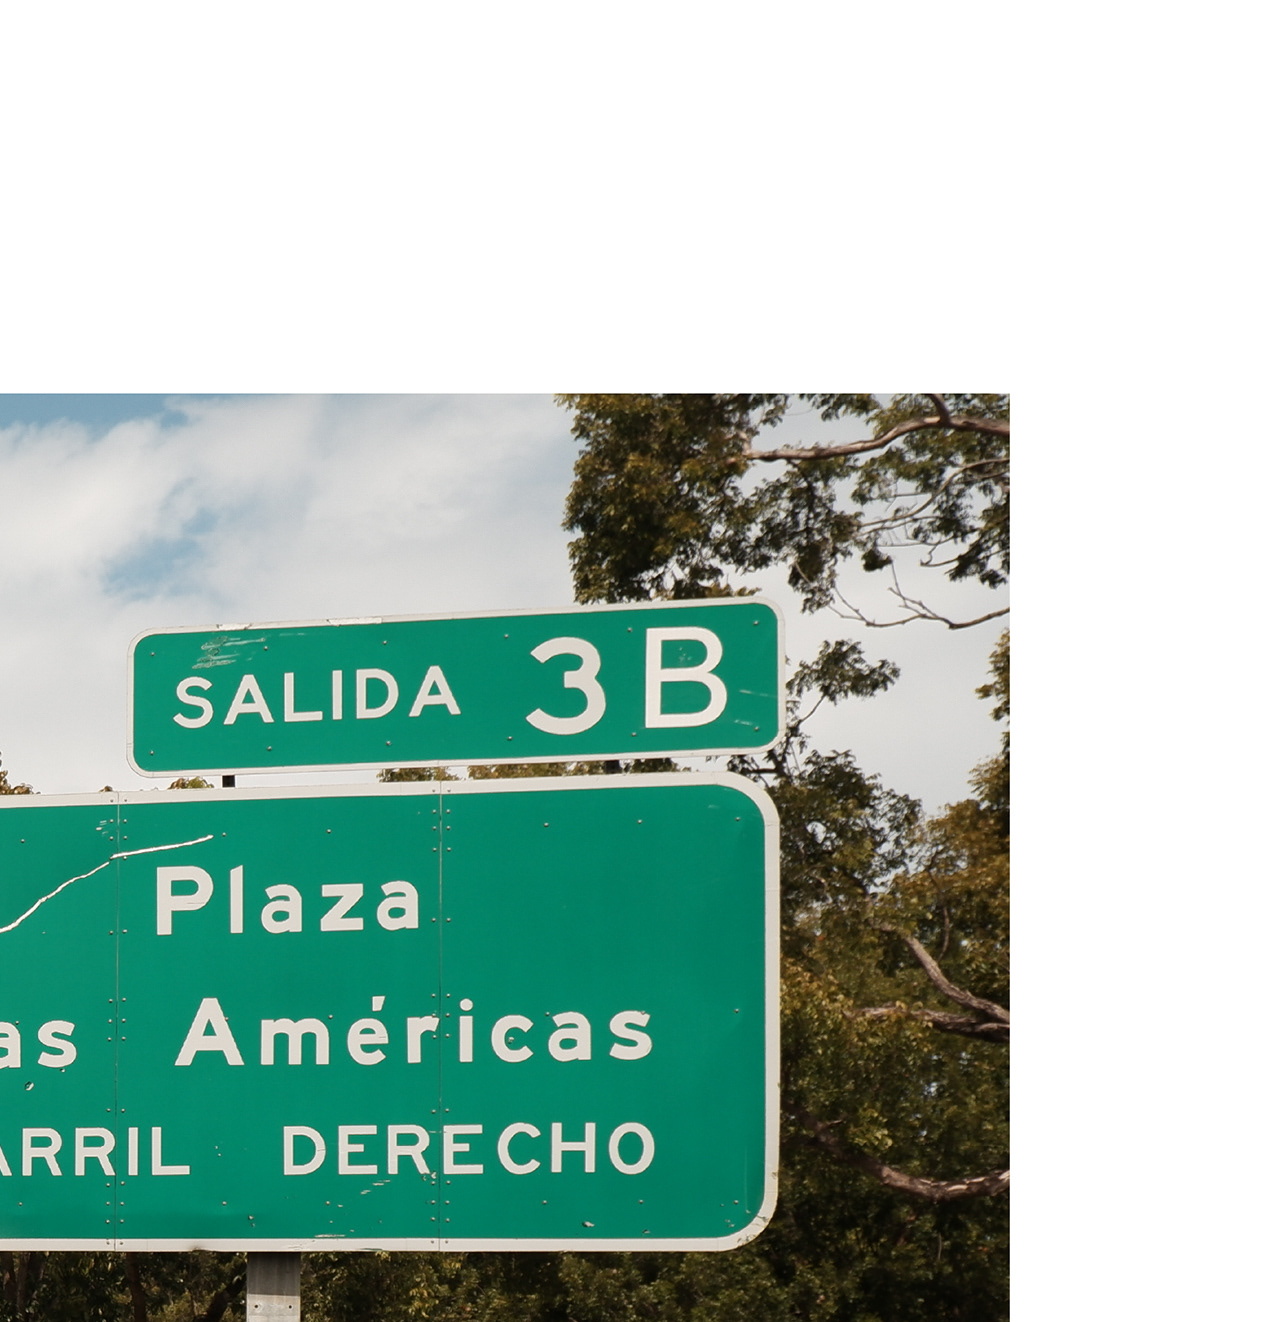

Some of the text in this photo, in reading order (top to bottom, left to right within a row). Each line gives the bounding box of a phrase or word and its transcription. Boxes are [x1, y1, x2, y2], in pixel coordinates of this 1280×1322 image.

[173, 665, 461, 729] SALIDA
[156, 864, 419, 936] Plaza
[174, 993, 653, 1067] Américas
[283, 1122, 655, 1179] DERECHO
